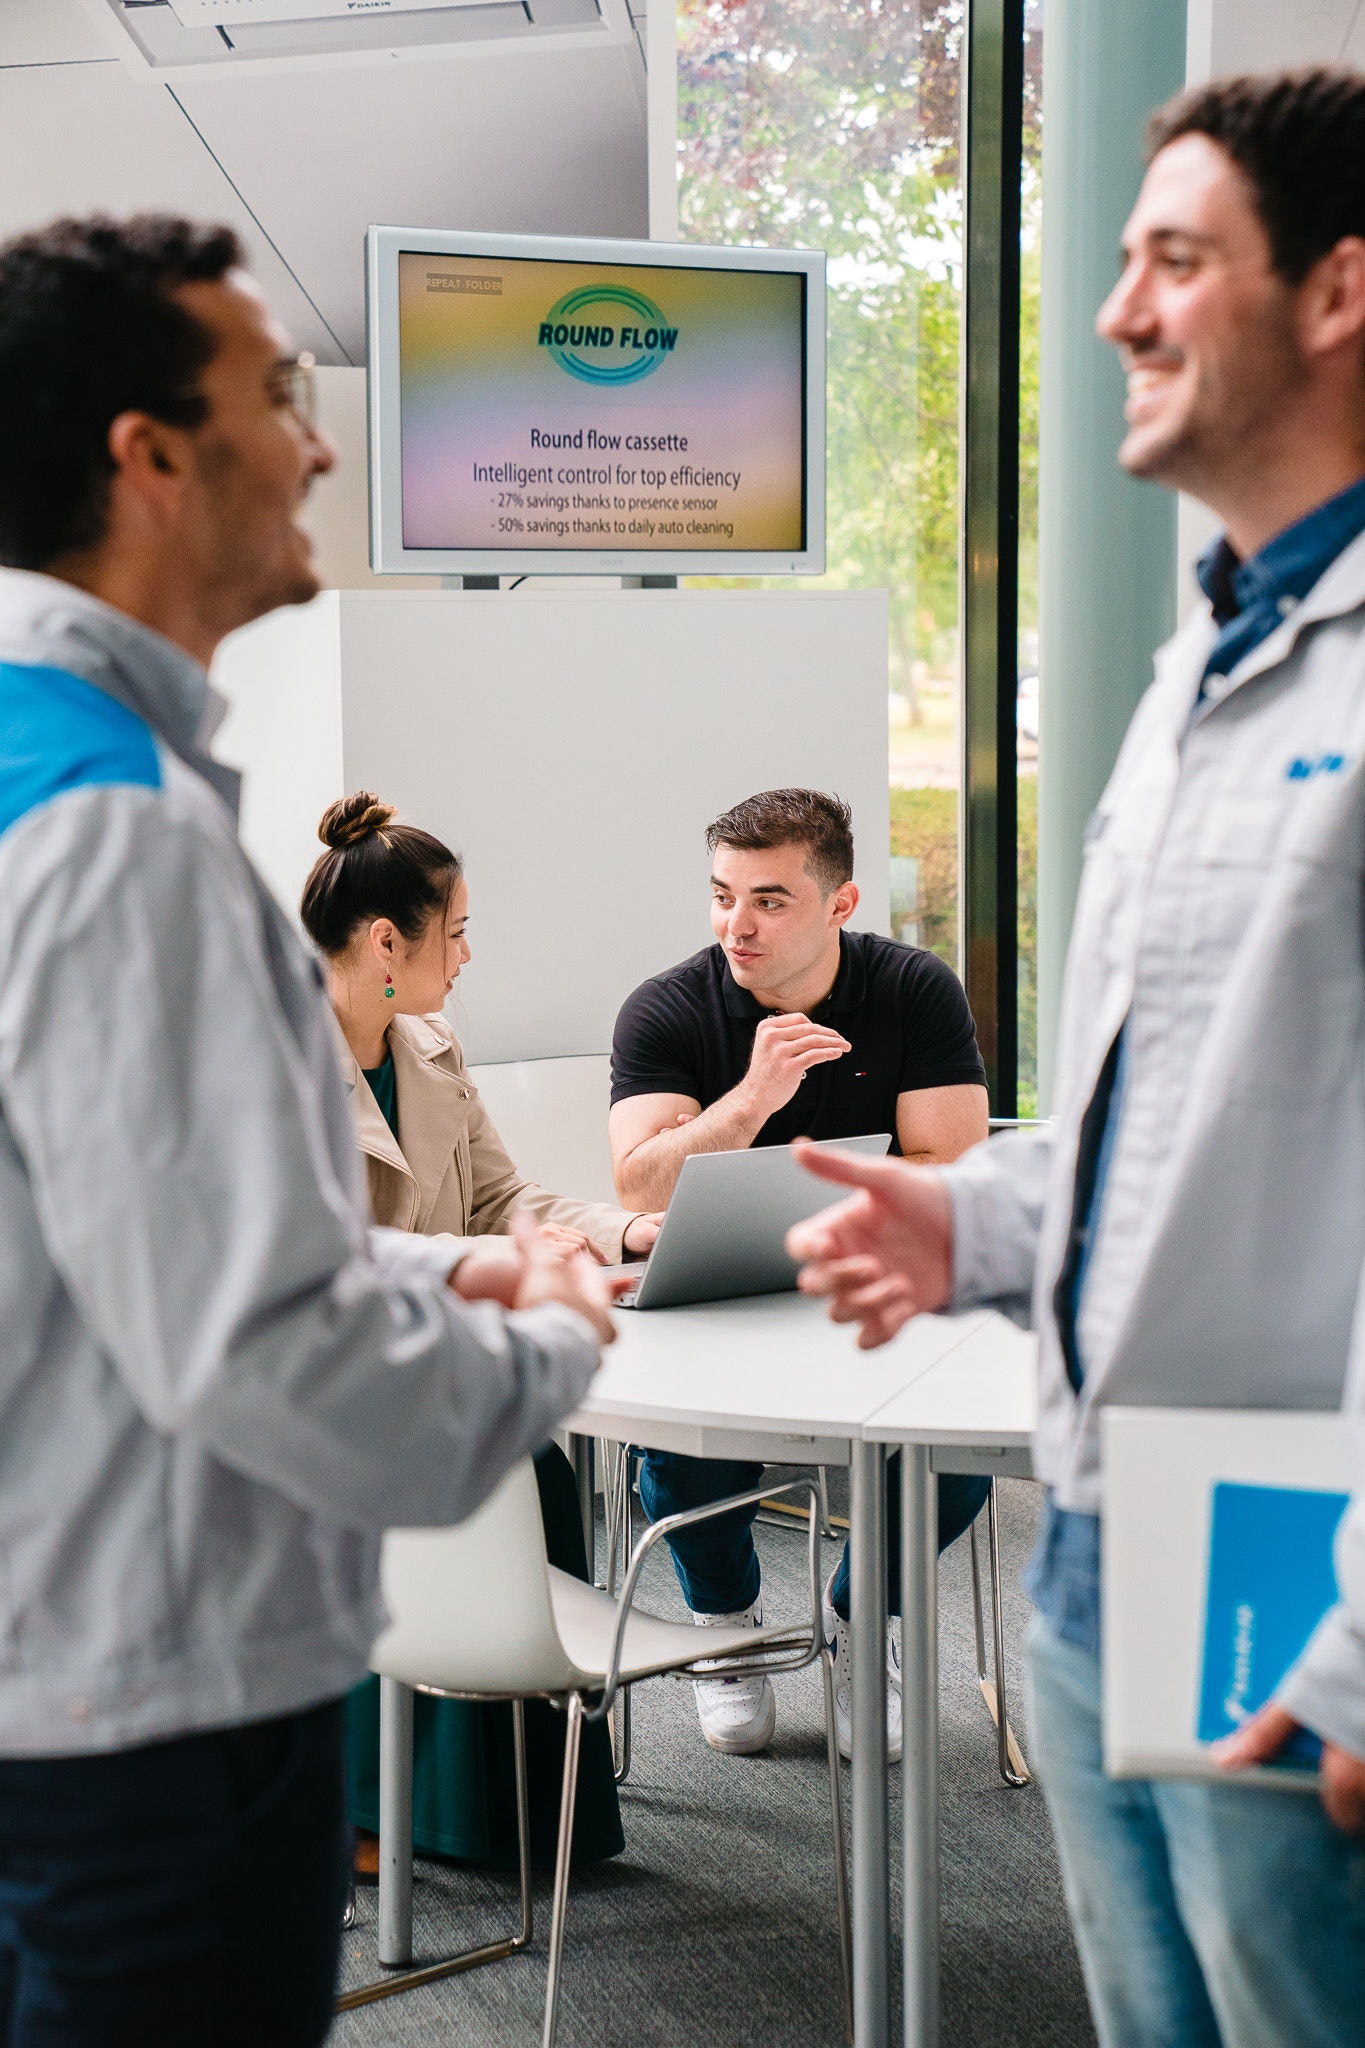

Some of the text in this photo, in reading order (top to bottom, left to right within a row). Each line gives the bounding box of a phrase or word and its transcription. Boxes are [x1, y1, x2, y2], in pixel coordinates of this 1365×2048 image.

[427, 278, 461, 289] REPEAT
[538, 323, 678, 350] ROUND FLOW
[530, 428, 688, 451] Round flow cassette
[473, 462, 741, 491] Intelligent control for top efficiency
[498, 493, 524, 508] 27%
[526, 495, 570, 512] savings
[572, 494, 611, 509] thanks
[613, 496, 626, 510] to
[628, 497, 680, 512] presence
[682, 499, 718, 511] sensor
[498, 517, 524, 533] 50%
[526, 518, 570, 537] savings
[572, 518, 611, 533] thanks
[613, 521, 626, 533] to
[628, 519, 656, 537] daily
[658, 522, 684, 535] auto
[686, 520, 734, 539] cleaning
